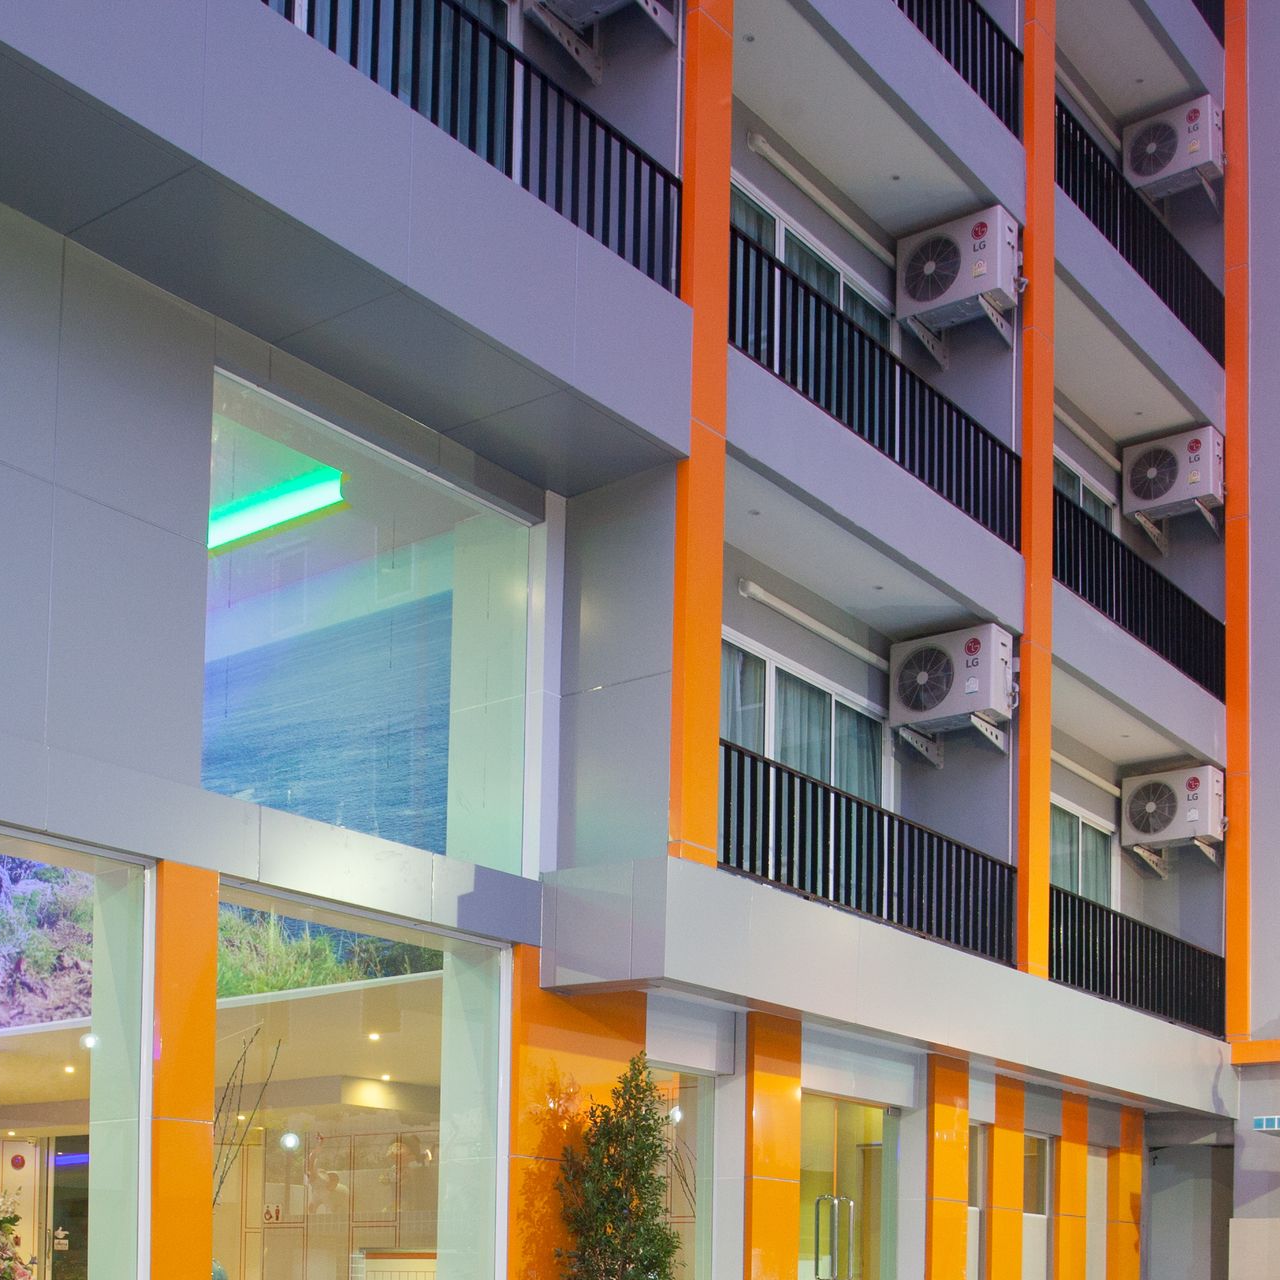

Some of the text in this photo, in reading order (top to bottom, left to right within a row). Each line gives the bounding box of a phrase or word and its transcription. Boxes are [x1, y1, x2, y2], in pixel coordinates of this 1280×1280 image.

[1187, 123, 1200, 134] LG
[972, 240, 987, 253] LG
[1188, 453, 1201, 464] LG
[965, 657, 980, 669] LG
[1186, 792, 1199, 802] LG
